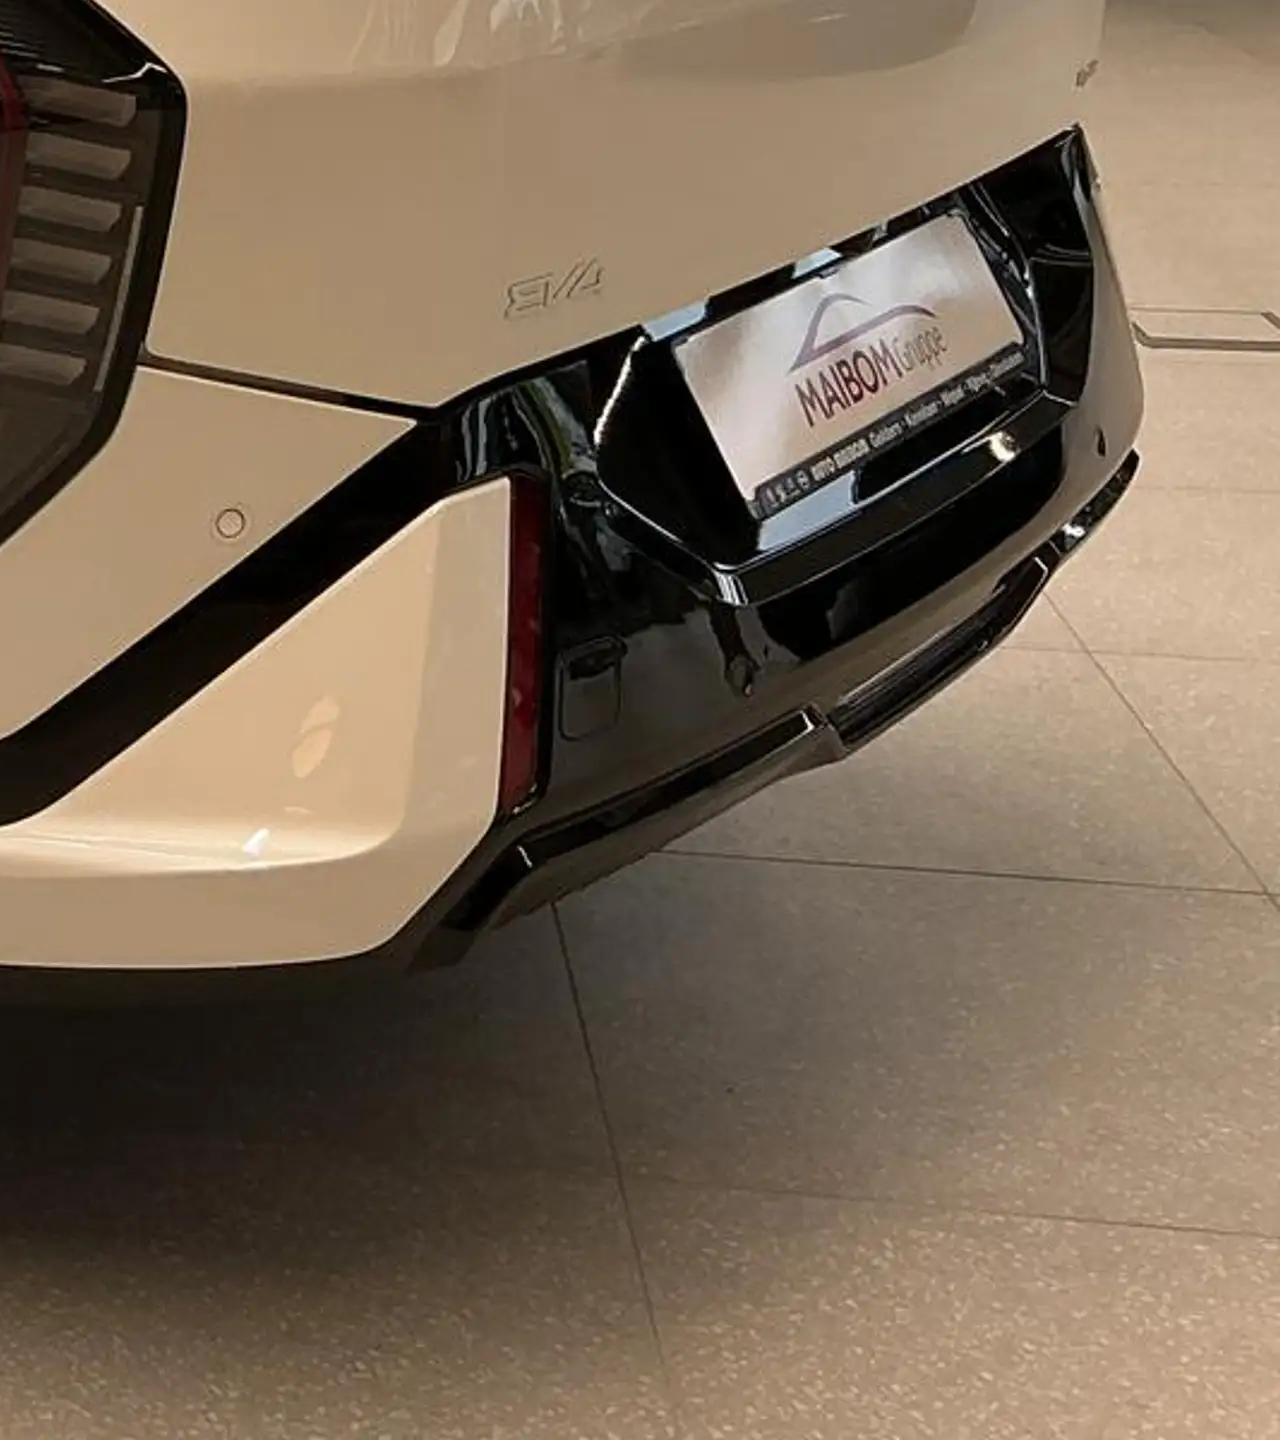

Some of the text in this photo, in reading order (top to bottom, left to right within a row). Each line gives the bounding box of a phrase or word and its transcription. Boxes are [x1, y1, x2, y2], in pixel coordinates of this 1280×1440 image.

[503, 258, 604, 319] EV4
[794, 338, 904, 428] MAIBOM
[891, 326, 948, 373] Gruppe
